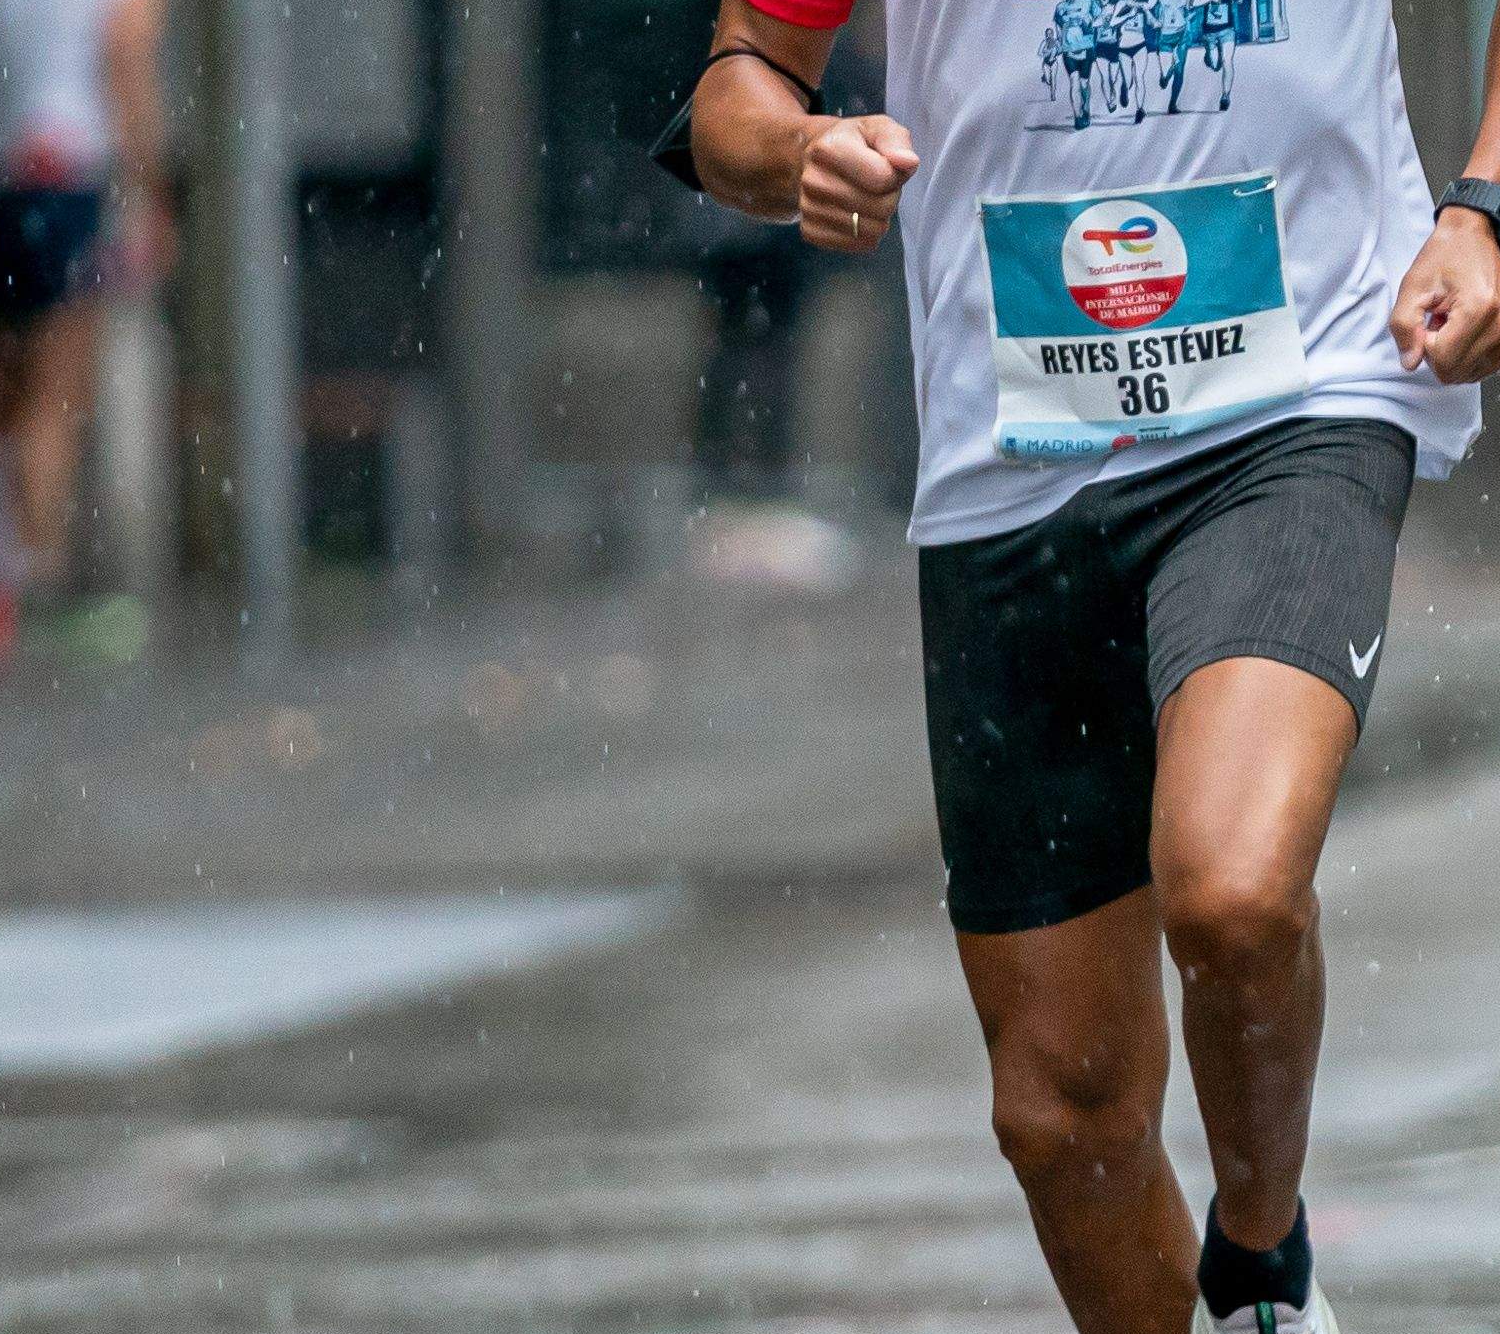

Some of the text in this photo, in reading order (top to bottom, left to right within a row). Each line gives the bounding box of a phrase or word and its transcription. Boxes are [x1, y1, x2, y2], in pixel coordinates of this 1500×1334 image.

[1087, 261, 1163, 276] TotalEnergies
[1108, 283, 1144, 295] MILLA
[1100, 304, 1161, 320] DE MADRID
[1040, 324, 1245, 374] REYES ESTÉVEZ
[1117, 371, 1170, 416] 36
[1027, 439, 1094, 453] MADRID
